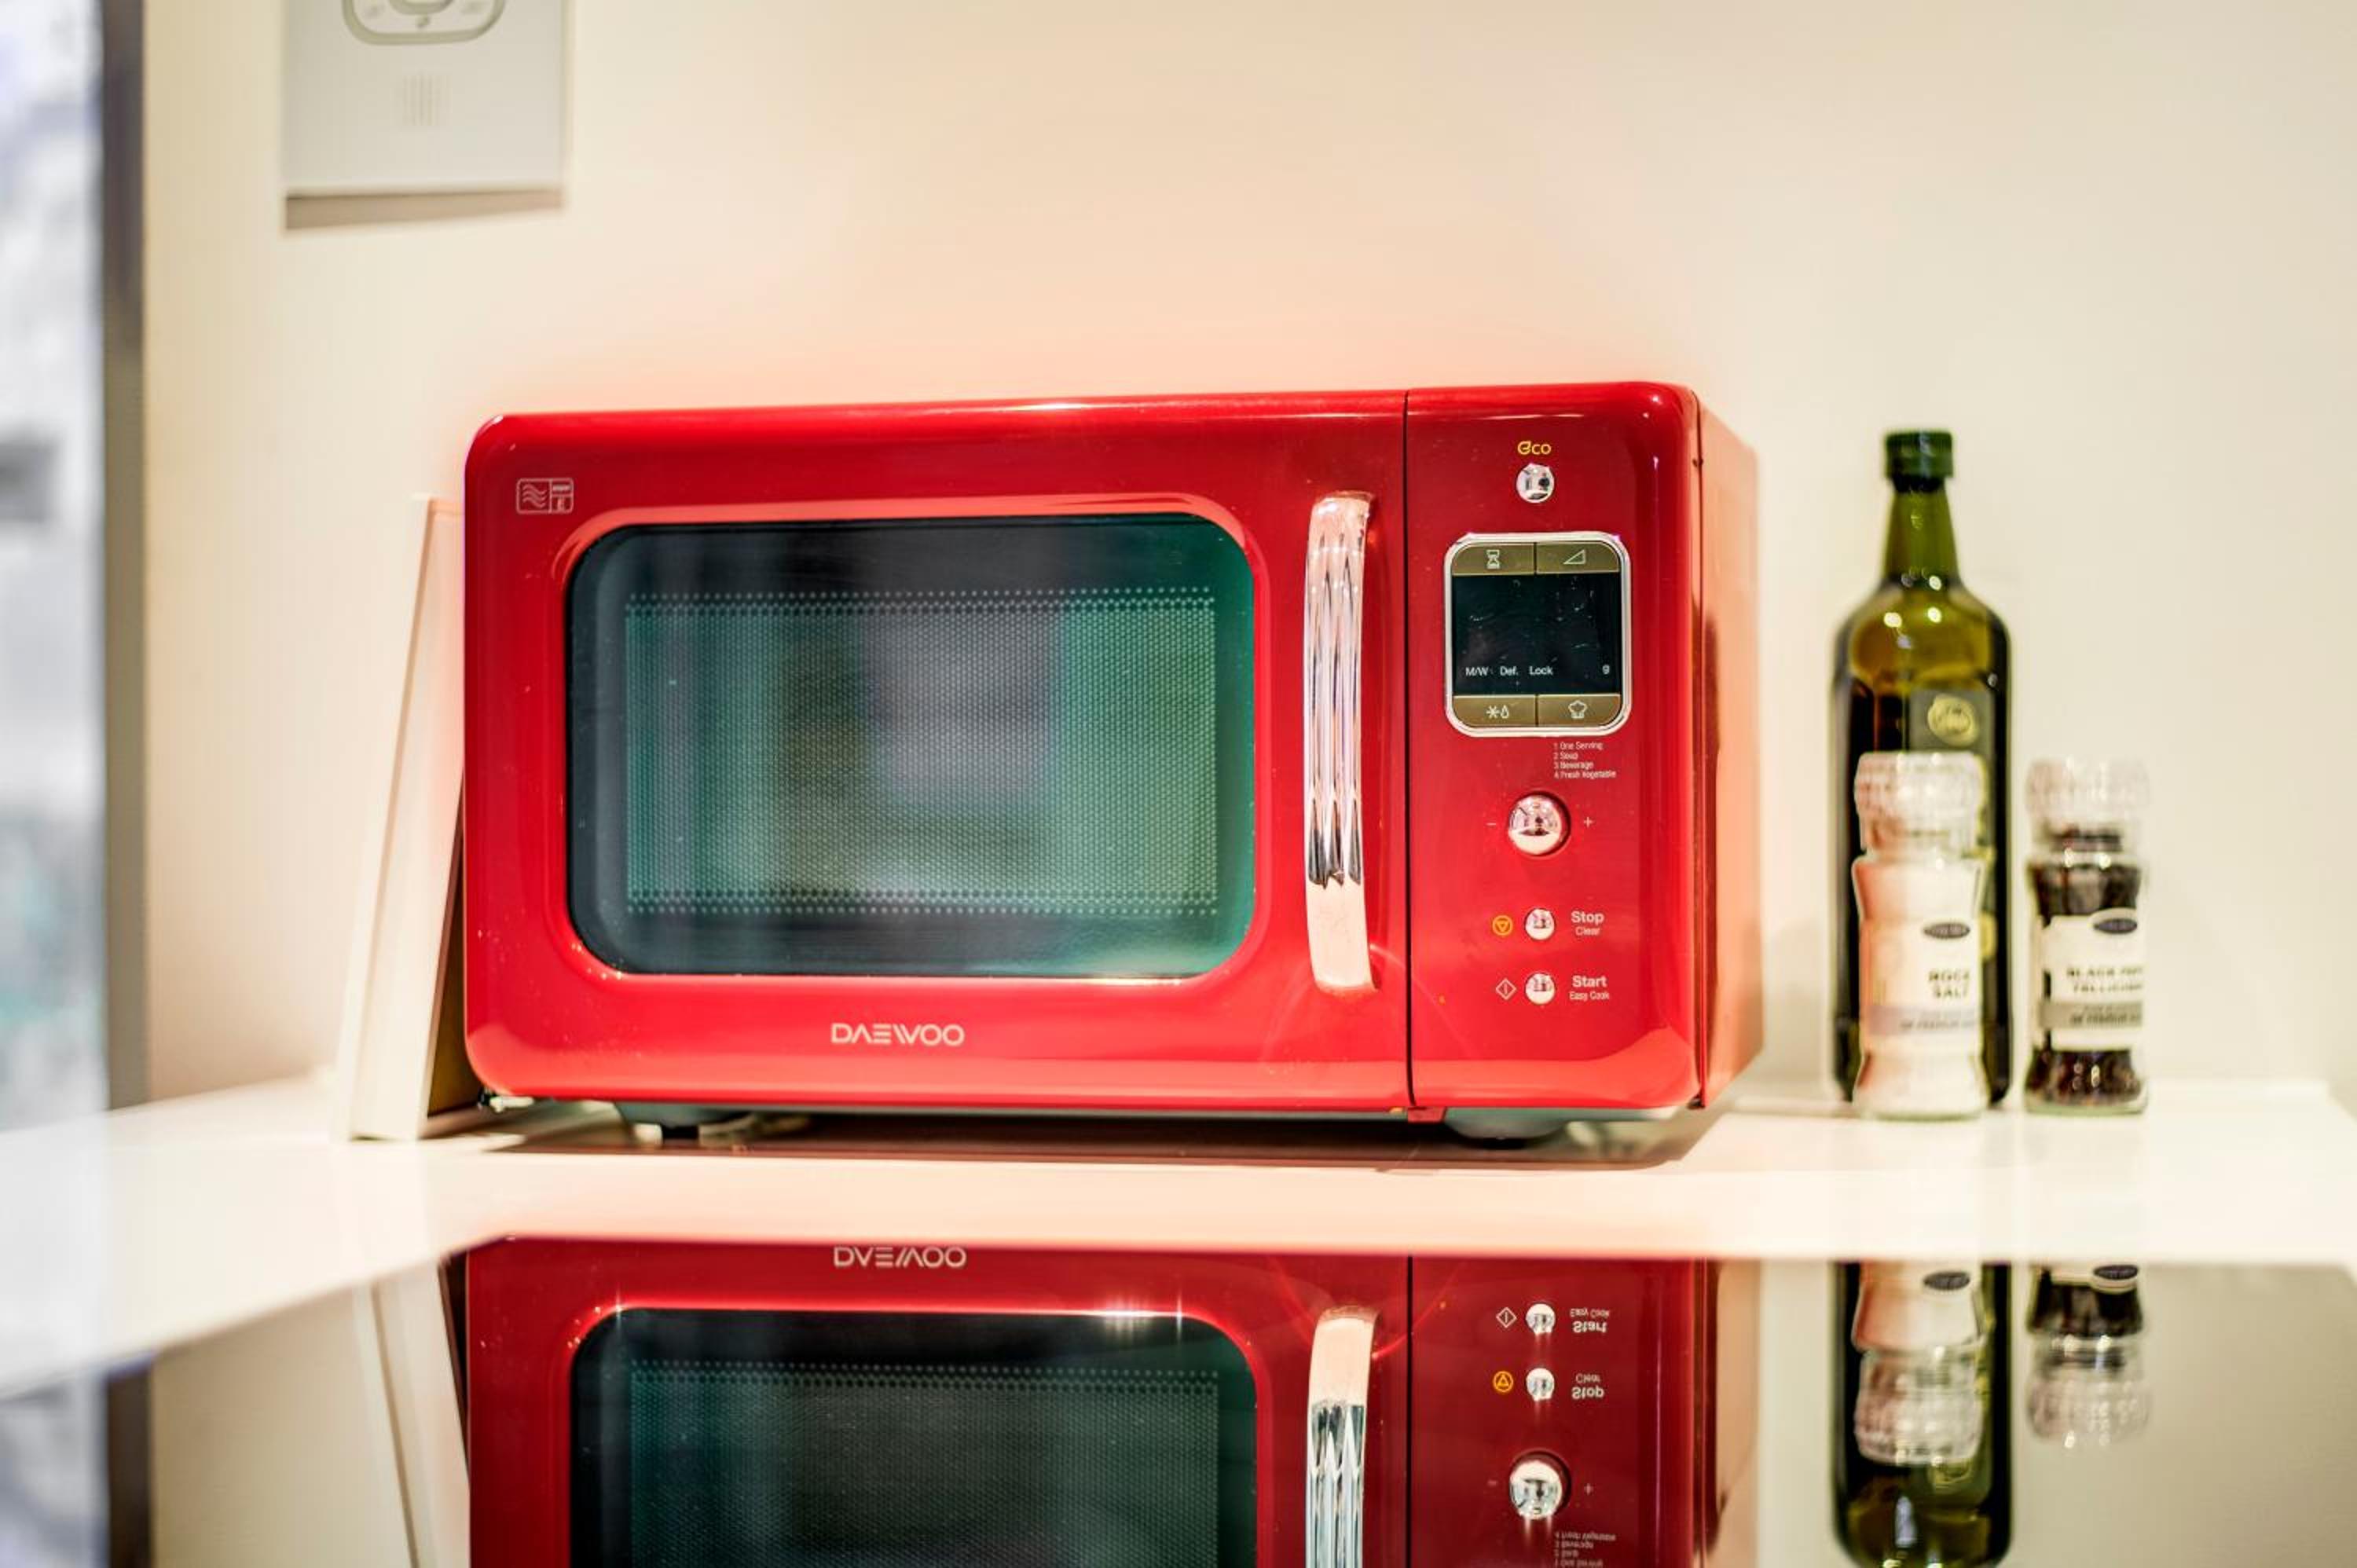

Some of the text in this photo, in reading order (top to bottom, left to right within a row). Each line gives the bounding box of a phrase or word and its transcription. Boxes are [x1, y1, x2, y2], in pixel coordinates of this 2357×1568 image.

[1529, 665, 1553, 676] Lock
[1560, 741, 1574, 750] One
[1575, 741, 1604, 751] Serving
[1571, 910, 1605, 925] Stop
[1574, 925, 1601, 936] Clear
[1572, 975, 1607, 988] Start
[1569, 990, 1610, 1002] Easy Cook
[831, 1022, 966, 1046] DAEWOO
